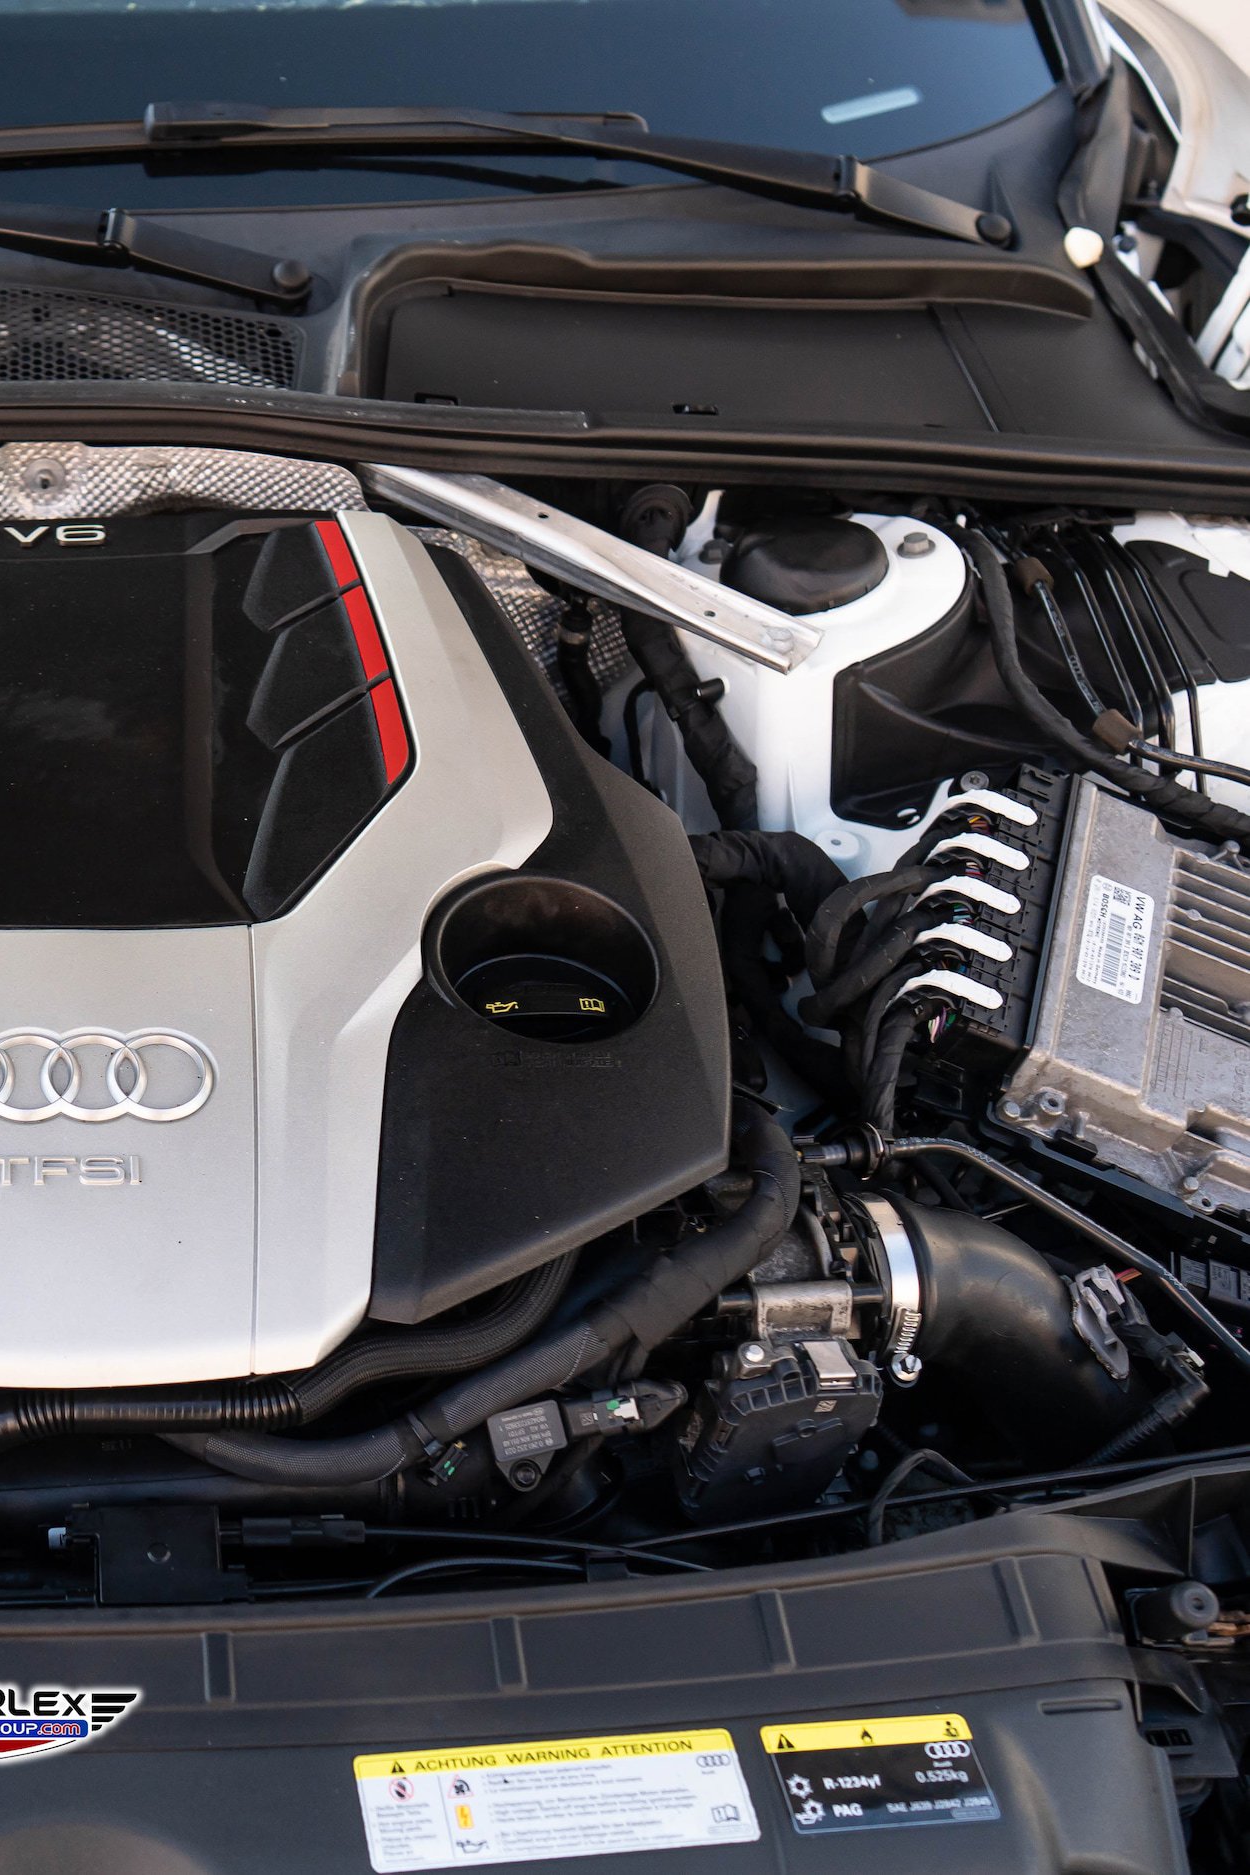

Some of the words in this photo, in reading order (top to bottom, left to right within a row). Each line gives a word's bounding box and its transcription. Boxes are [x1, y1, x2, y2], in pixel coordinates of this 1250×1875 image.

[3, 524, 106, 547] V6
[1099, 893, 1109, 918] BOSCH
[414, 1755, 497, 1772] ACHTUNG
[506, 1748, 590, 1764] WARNING
[600, 1740, 693, 1757] ATTENTION
[915, 1769, 969, 1784] 0.525kg
[832, 1802, 864, 1818] PAG
